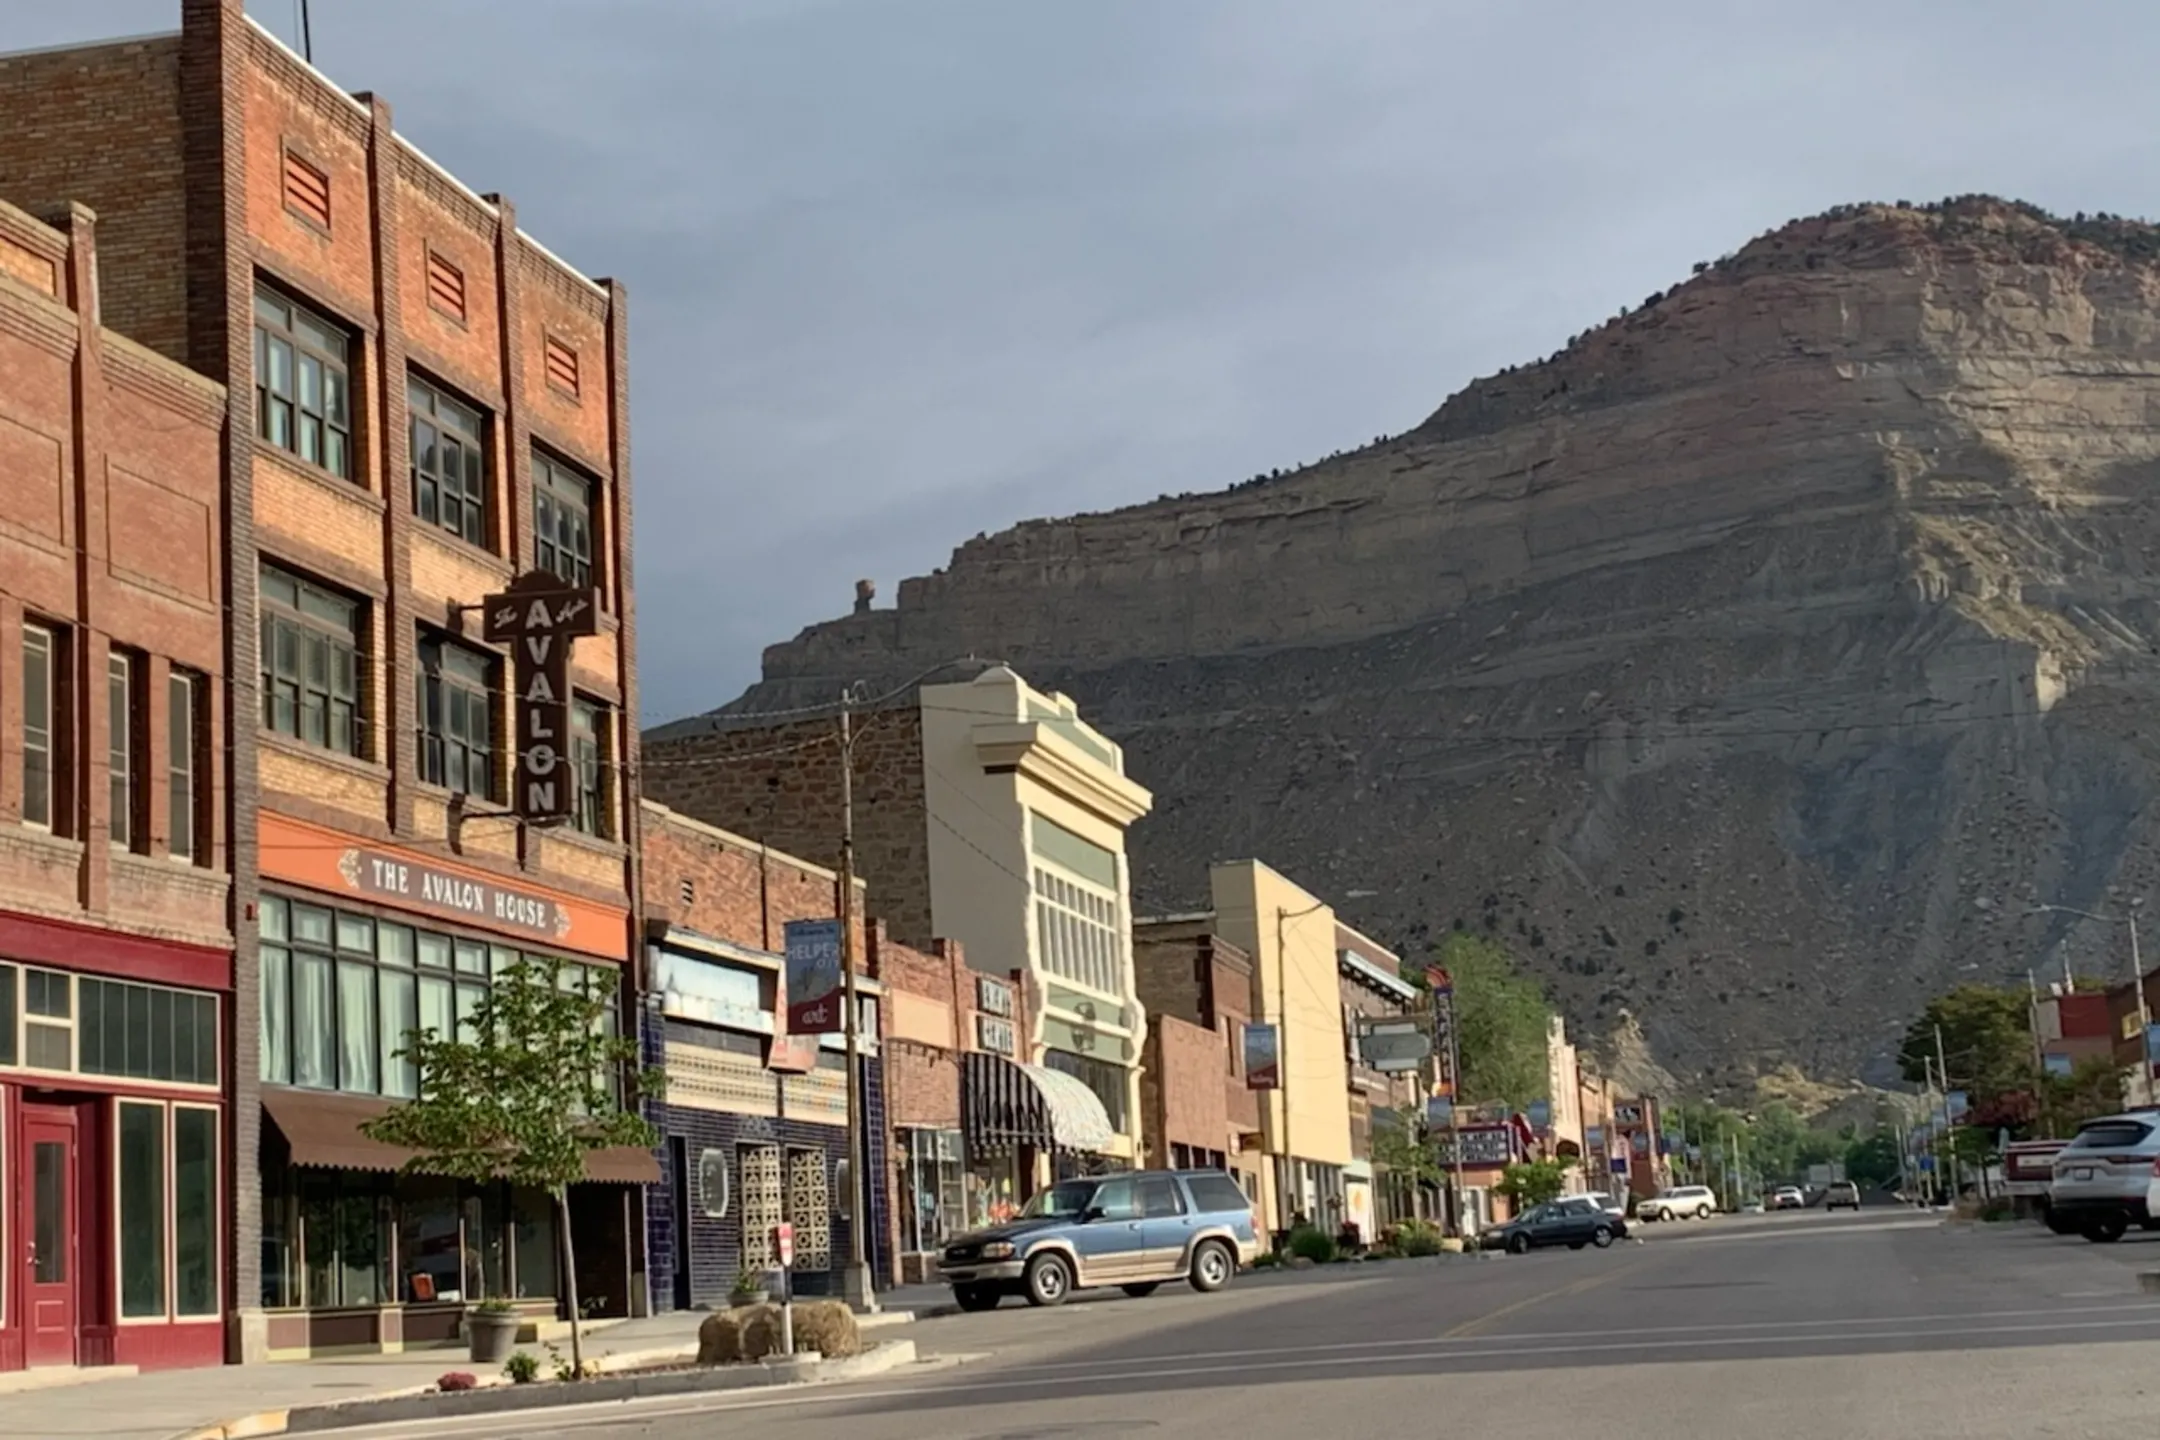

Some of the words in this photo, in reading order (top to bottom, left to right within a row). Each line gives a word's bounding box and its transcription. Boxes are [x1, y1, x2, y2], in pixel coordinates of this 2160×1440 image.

[525, 598, 556, 813] AVALON
[371, 859, 409, 894] THE
[421, 873, 484, 914] AVALON
[494, 891, 546, 929] HOUSE
[801, 1003, 829, 1025] art
